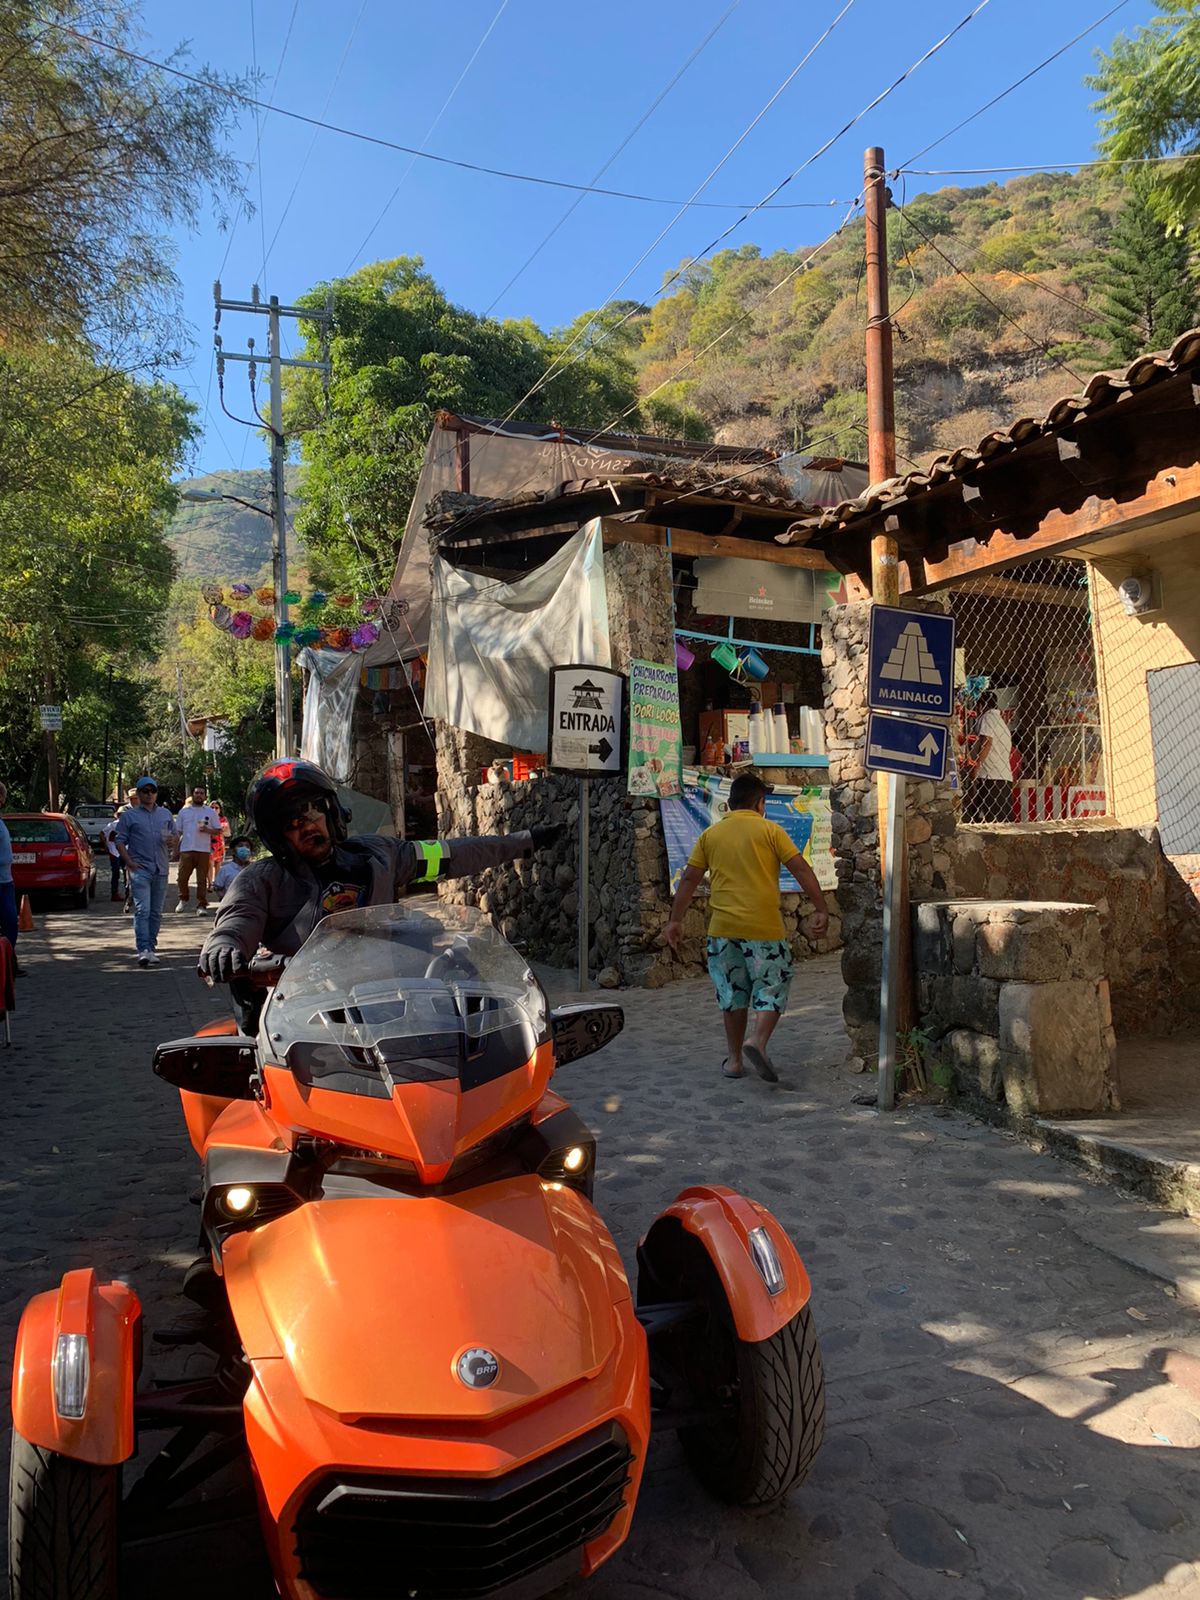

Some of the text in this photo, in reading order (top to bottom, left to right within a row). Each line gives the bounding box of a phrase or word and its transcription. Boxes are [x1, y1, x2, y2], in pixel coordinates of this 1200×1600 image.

[878, 688, 943, 705] MALINALCO
[559, 711, 616, 733] ENTRADA
[476, 1365, 497, 1375] BRP
